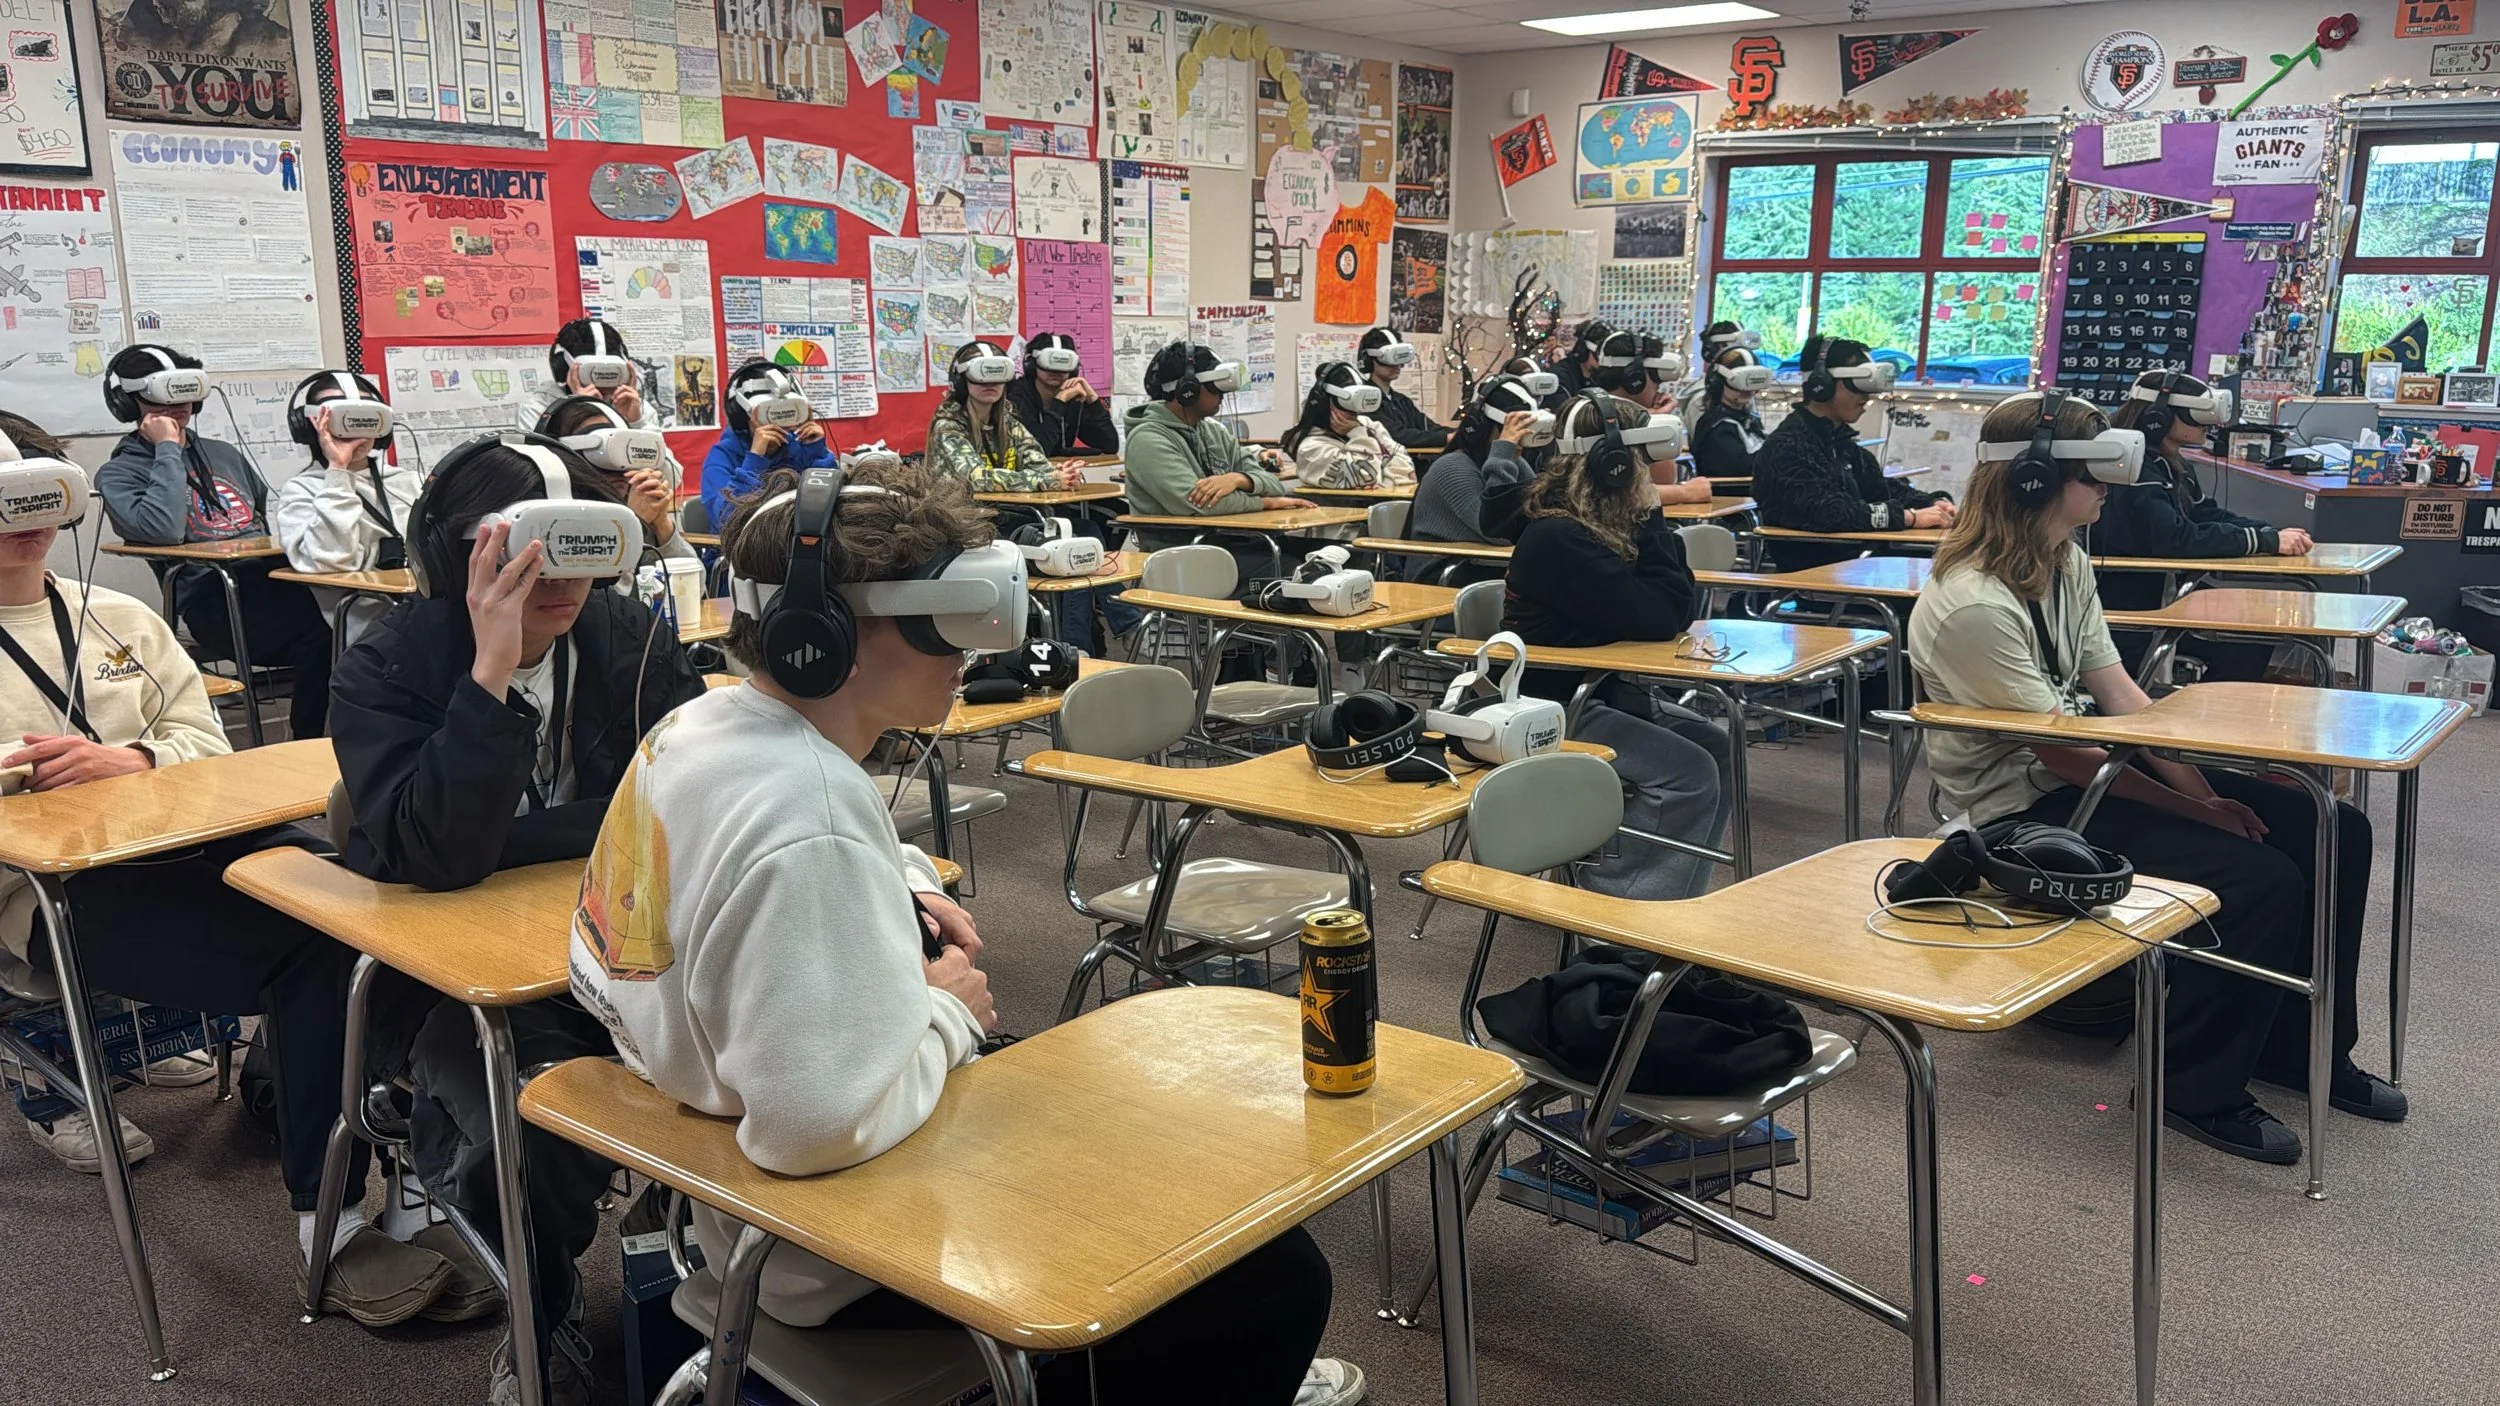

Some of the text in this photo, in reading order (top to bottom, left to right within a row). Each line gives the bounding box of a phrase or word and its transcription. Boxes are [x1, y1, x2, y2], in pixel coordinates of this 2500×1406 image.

[148, 51, 286, 71] DARYL DIXON WANTS
[1728, 36, 1785, 116] SF
[150, 61, 288, 120] YOU
[158, 83, 188, 106] TO
[2236, 126, 2309, 137] AUTHENTIC
[17, 129, 72, 153] $450
[2235, 138, 2305, 160] GIANTS
[2254, 160, 2281, 168] FAN
[1325, 219, 1370, 237] UMMINS
[2076, 261, 2193, 272] 1 2 3 4 5 6
[2072, 294, 2192, 305] 7 8 9 10 11 12
[764, 324, 835, 337] US IMPERIALISM
[2065, 325, 2188, 338] 13 14 15 16 17 18
[422, 348, 460, 361] CIVIL
[465, 348, 487, 361] WAR
[2063, 356, 2077, 367] 19
[2083, 357, 2098, 368] 20
[2104, 357, 2120, 368] 21
[2126, 357, 2142, 368] 22
[220, 381, 255, 396] CIVIL
[2079, 388, 2094, 399] 26
[2099, 390, 2115, 401] 27
[4, 491, 63, 507] TRIUMPH
[21, 500, 62, 514] SPIRIT
[2417, 504, 2453, 512] DO NOT
[2412, 513, 2454, 521] DISTURB
[559, 535, 617, 545] TRIUMPH
[571, 546, 615, 555] SPIRIT
[1029, 642, 1052, 676] 14
[94, 663, 143, 680] Brixton
[1345, 731, 1414, 766] POLSEN
[2028, 876, 2124, 900] POLSEN
[1316, 951, 1370, 968] ROCKSTAR
[1352, 964, 1369, 973] DRINK
